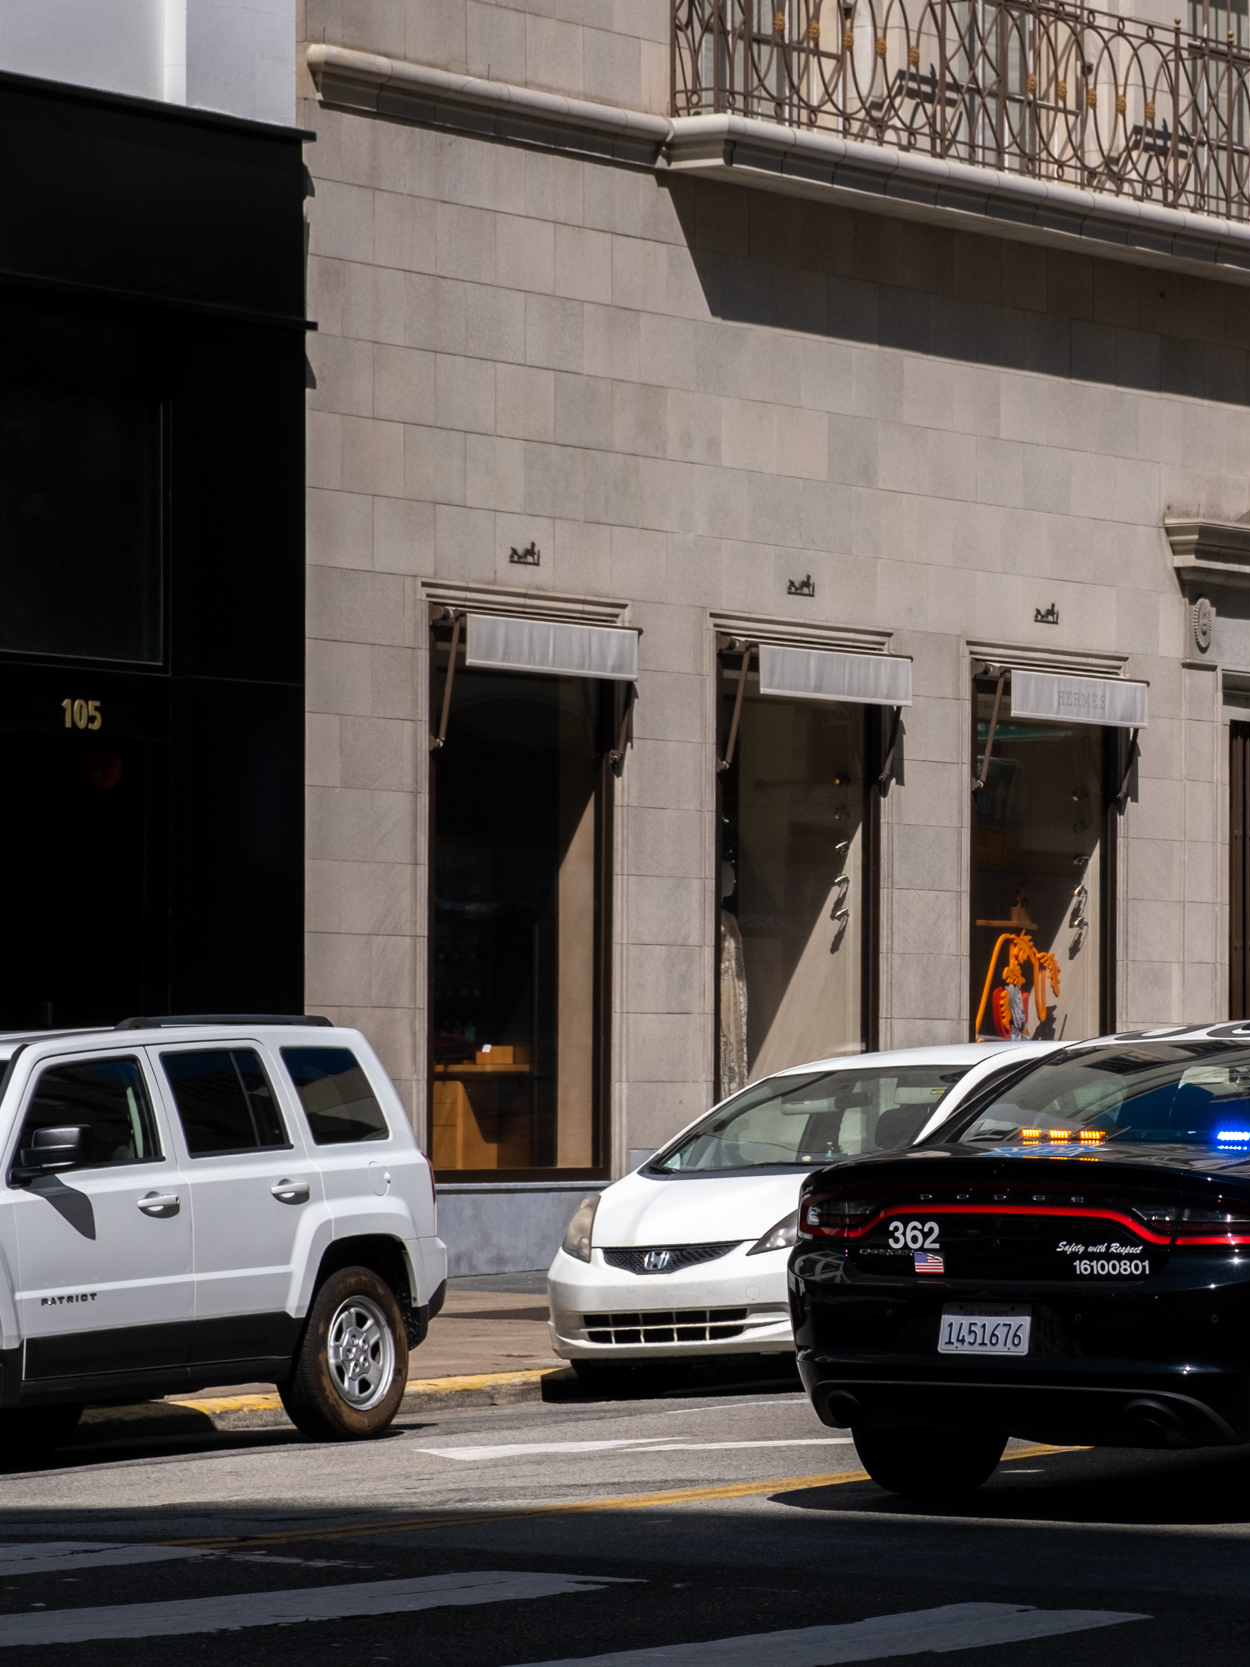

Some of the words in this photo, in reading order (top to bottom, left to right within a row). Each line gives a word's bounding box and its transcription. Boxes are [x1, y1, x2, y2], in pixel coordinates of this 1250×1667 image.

[61, 698, 102, 730] 105
[919, 1193, 1084, 1204] DODGE
[888, 1220, 941, 1250] 362
[1056, 1241, 1085, 1255] Safety
[1087, 1242, 1108, 1253] with
[1109, 1242, 1143, 1255] Respect
[1073, 1260, 1150, 1275] 16100801
[41, 1292, 98, 1307] PATRIOT
[944, 1321, 1024, 1347] 1451676
